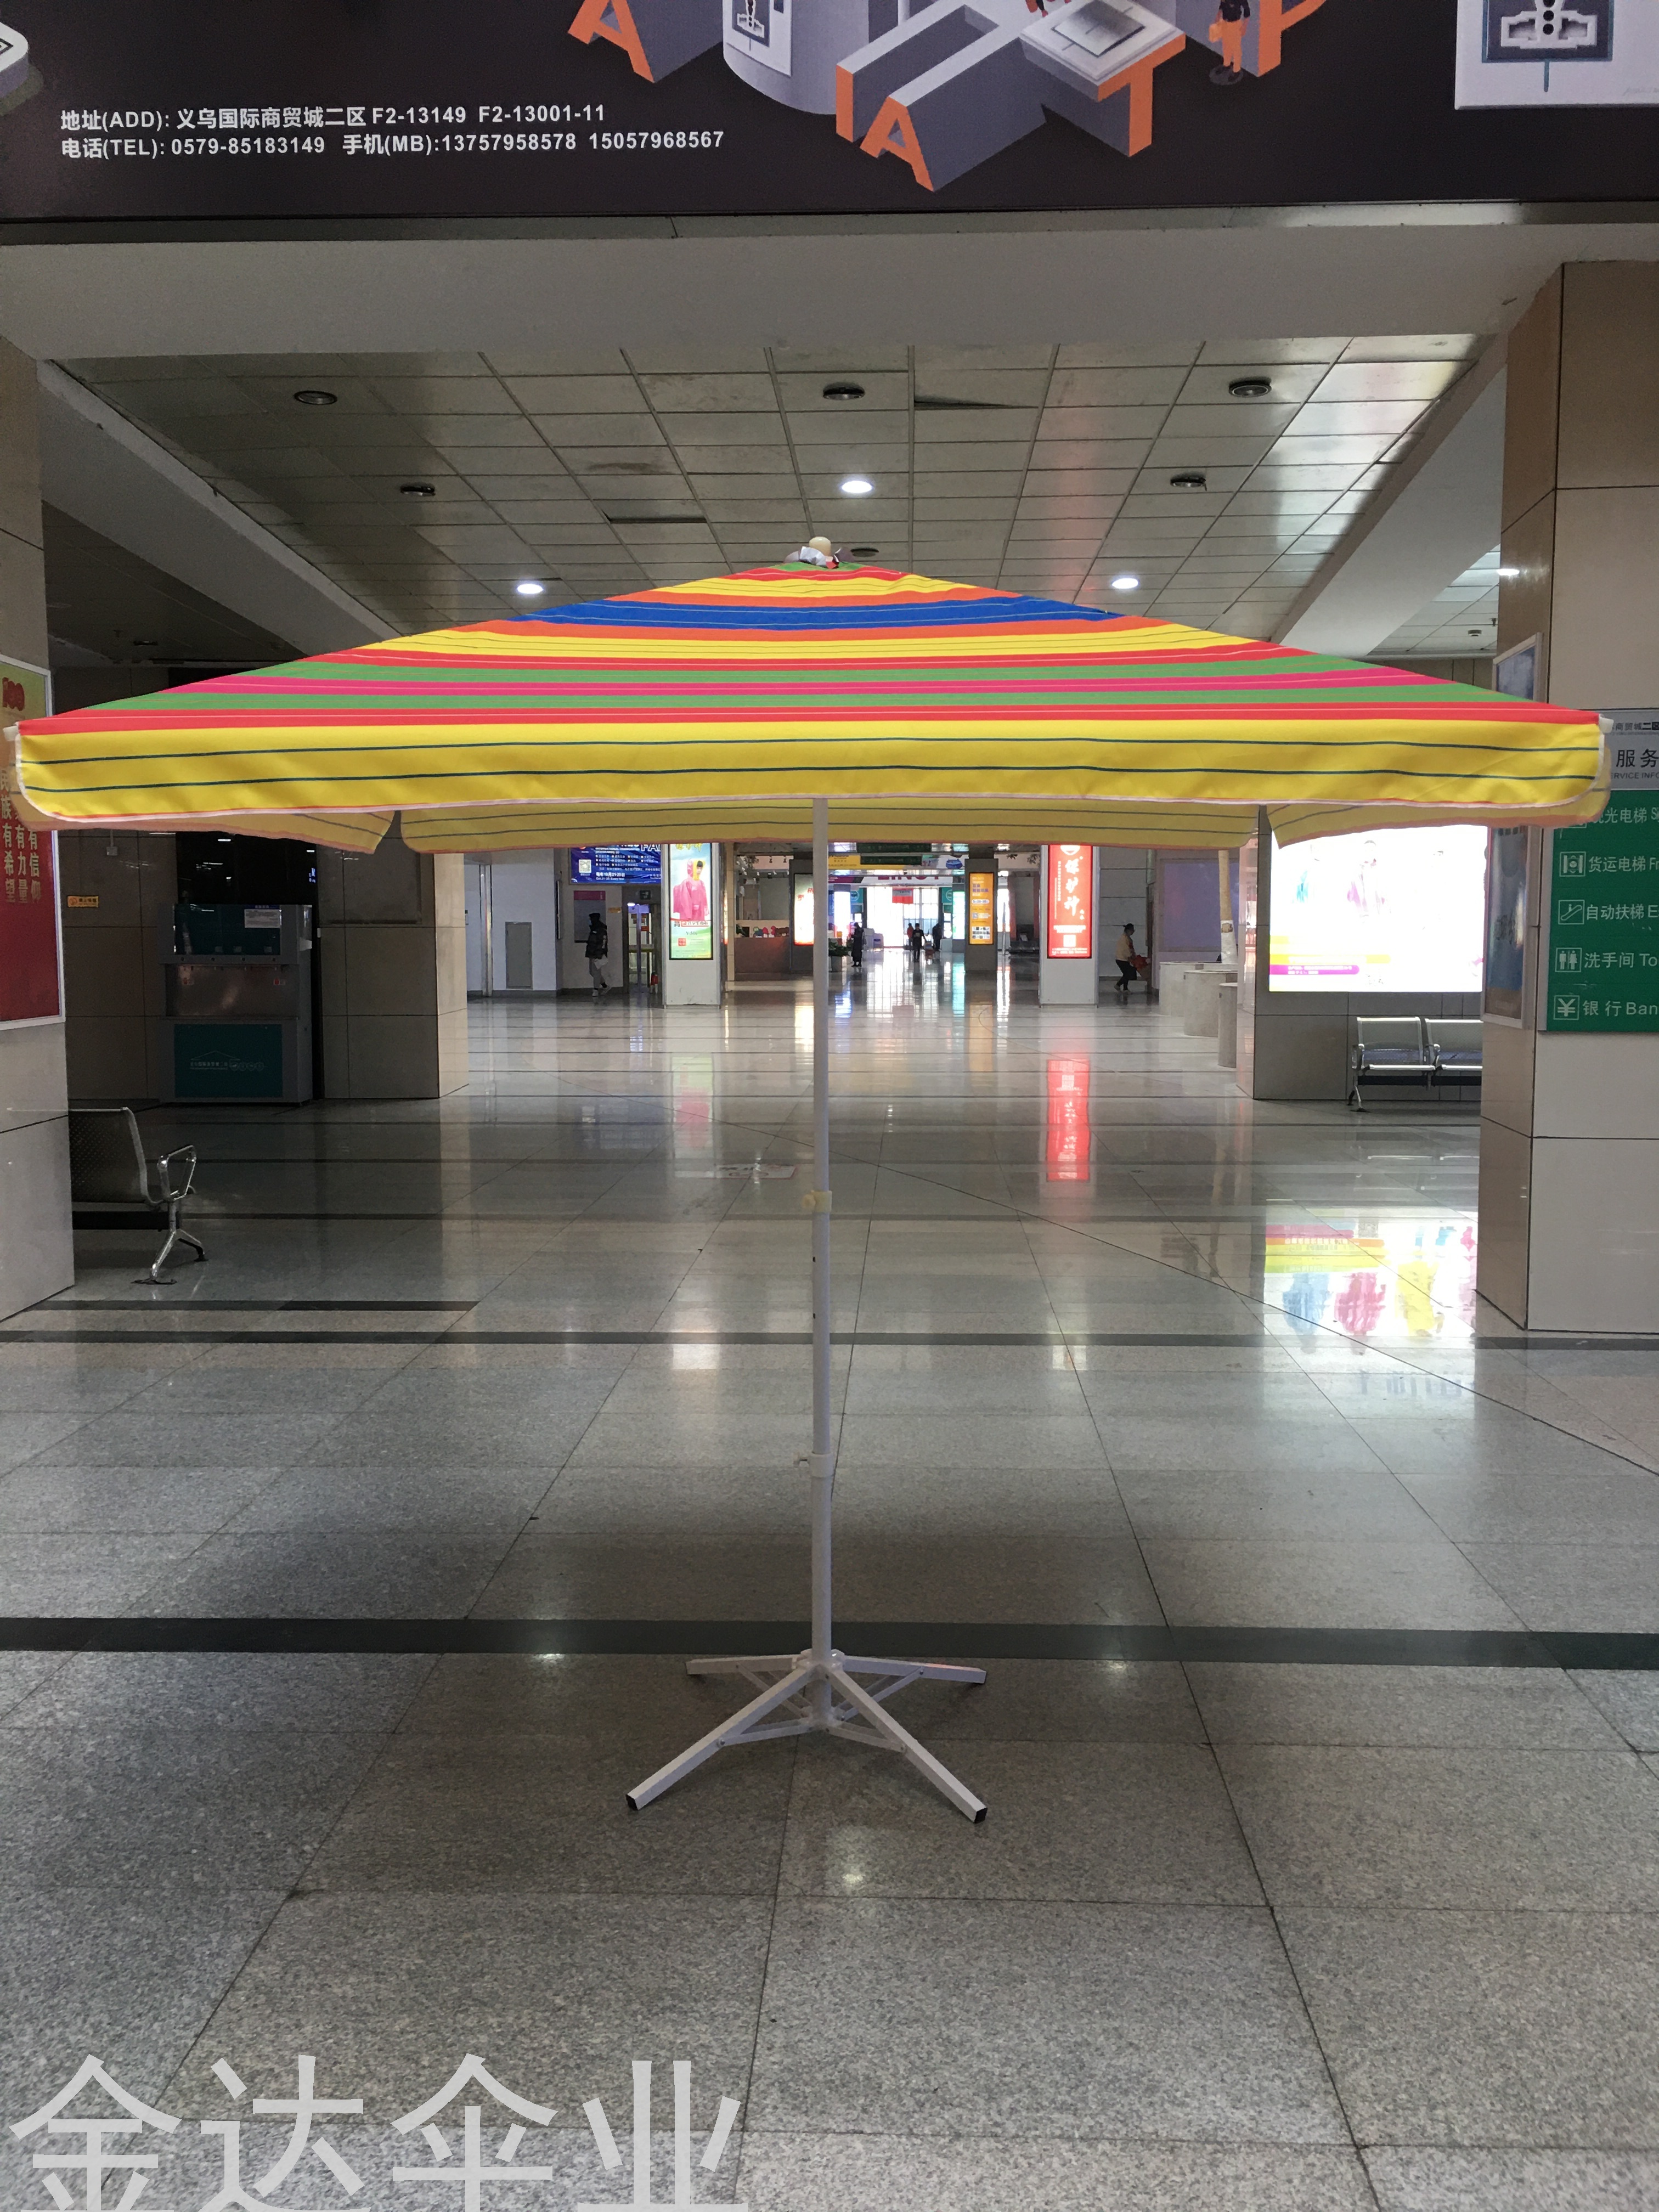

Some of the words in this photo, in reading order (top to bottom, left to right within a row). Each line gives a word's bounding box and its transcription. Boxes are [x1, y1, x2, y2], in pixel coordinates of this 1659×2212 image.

[60, 109, 170, 132] 地址(ADD):
[176, 106, 366, 129] 义乌国际商贸城二区
[373, 106, 467, 124] F2-13149
[478, 104, 604, 122] F2-13001-11
[61, 137, 165, 160] 电话(TEL):
[171, 136, 325, 156] 0579-85183149
[589, 131, 725, 149] 15057968567
[1616, 748, 1659, 768] 服务
[15, 813, 28, 904] 有力量
[1589, 856, 1646, 872] 货运电梯
[1587, 904, 1644, 920] 自动扶梯
[1584, 952, 1634, 968] 洗手间
[1582, 1000, 1622, 1017] 银行
